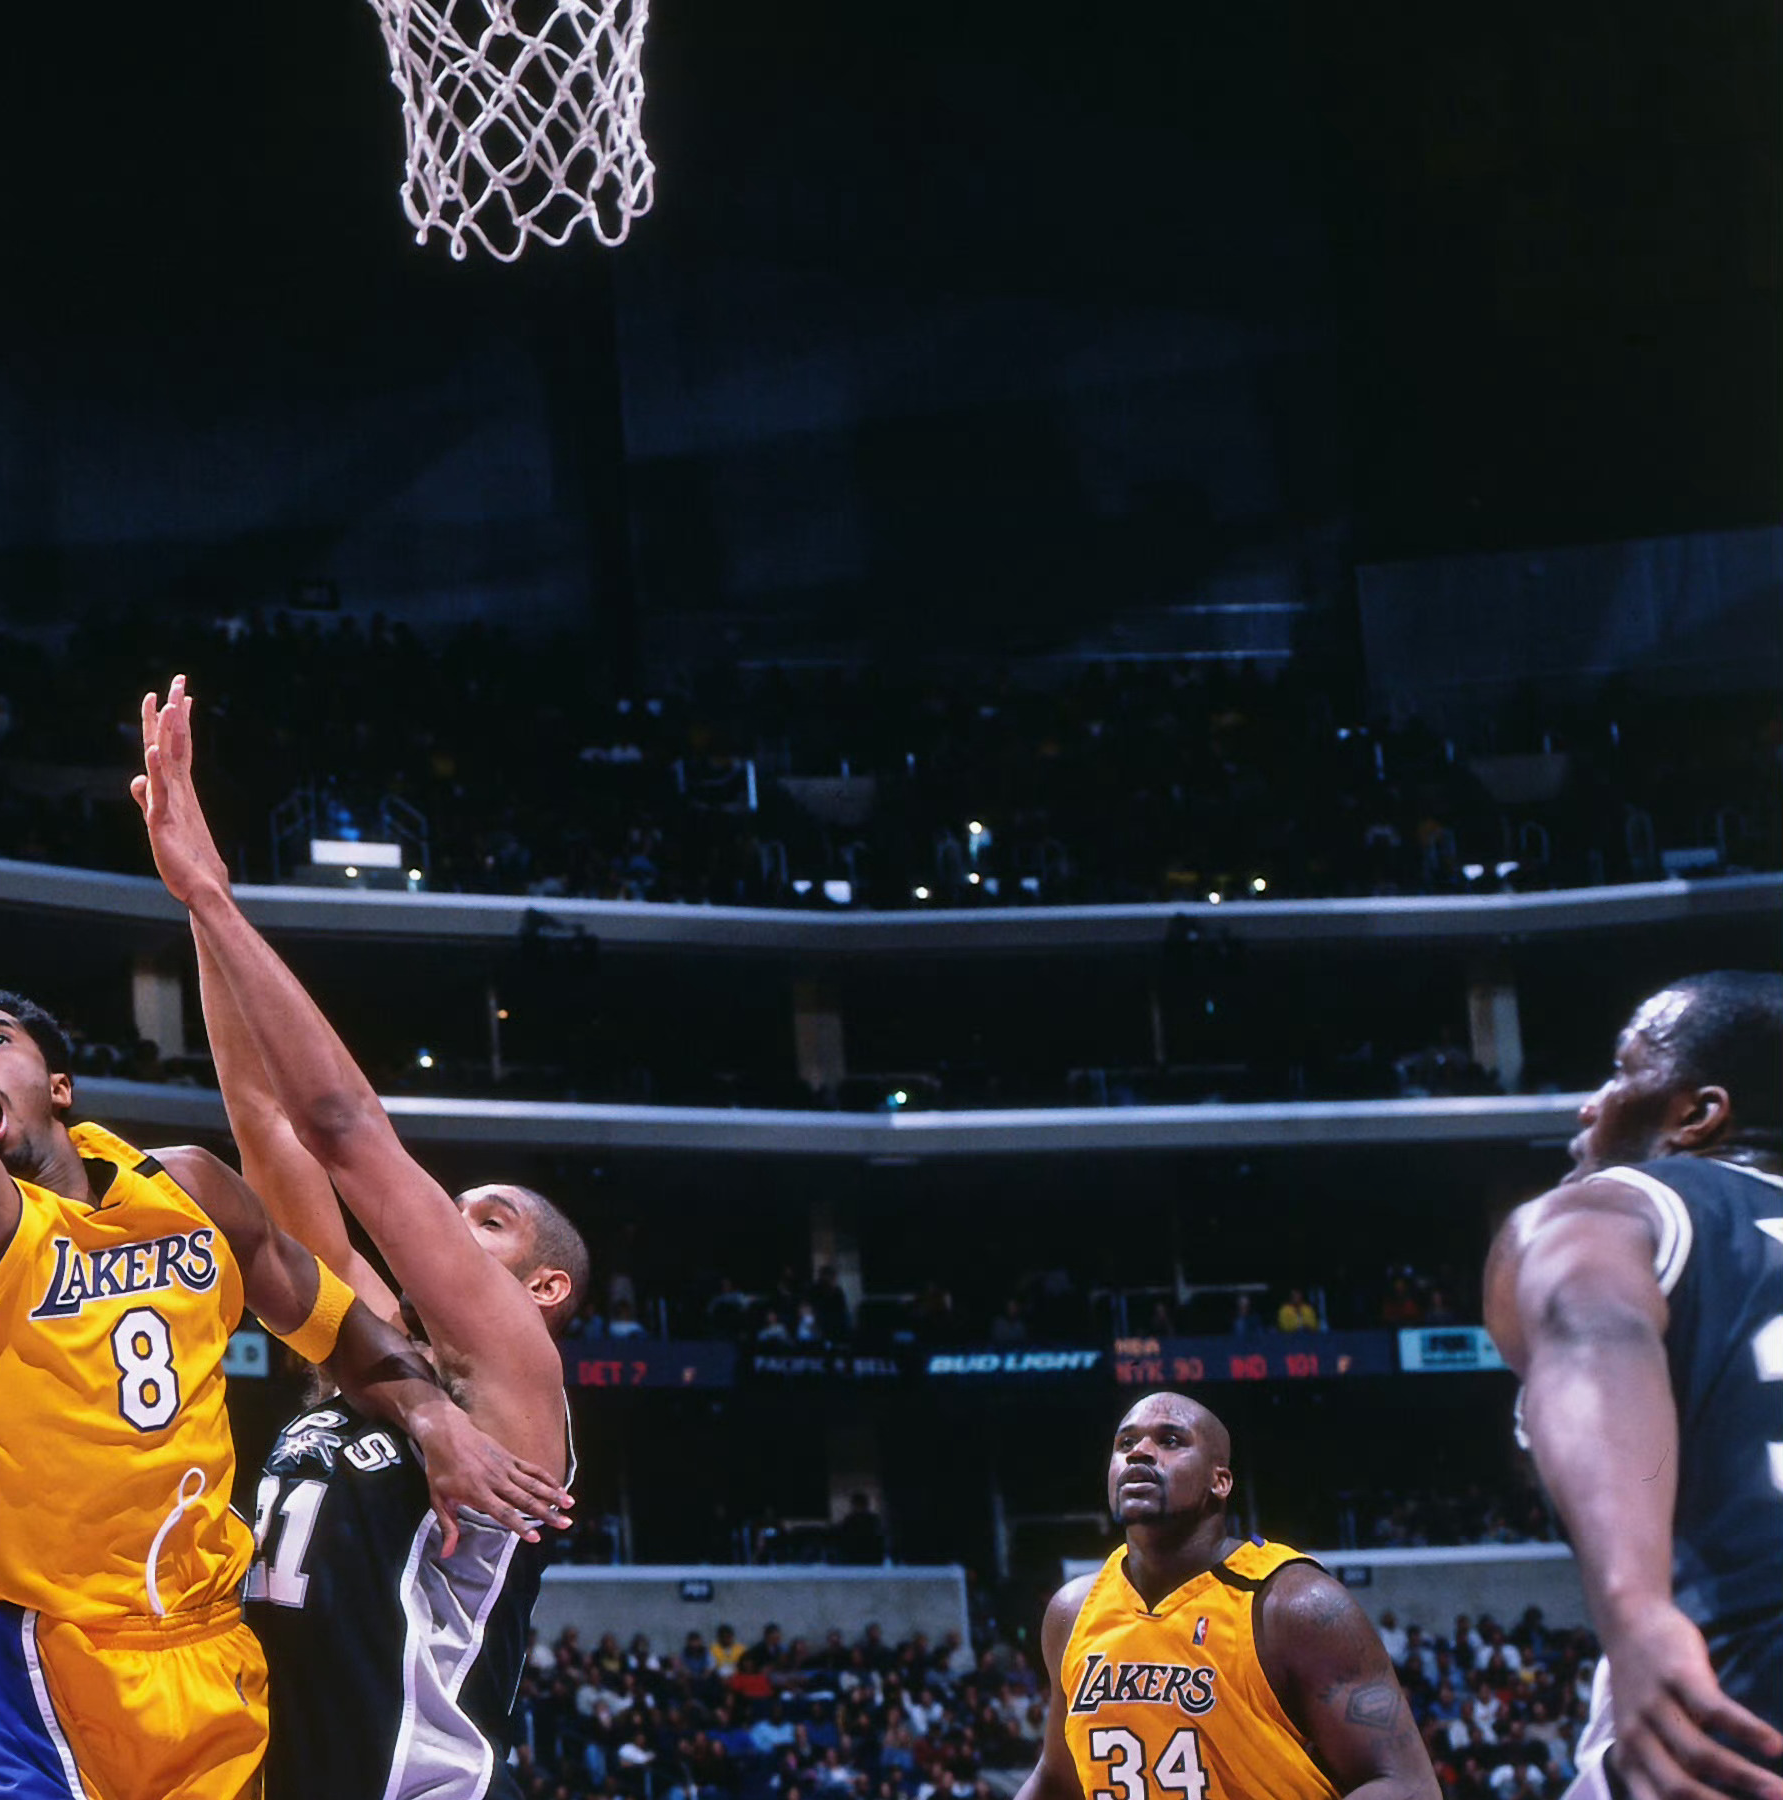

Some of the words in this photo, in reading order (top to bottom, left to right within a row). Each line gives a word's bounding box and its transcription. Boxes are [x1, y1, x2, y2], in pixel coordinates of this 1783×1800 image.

[27, 1227, 217, 1321] LAKERS
[110, 1306, 180, 1433] 8
[578, 1361, 623, 1387] DET
[853, 1357, 899, 1377] BELL
[928, 1354, 1001, 1374] BUD
[1003, 1350, 1102, 1372] LIGHT
[1068, 1653, 1217, 1716] LAKERS
